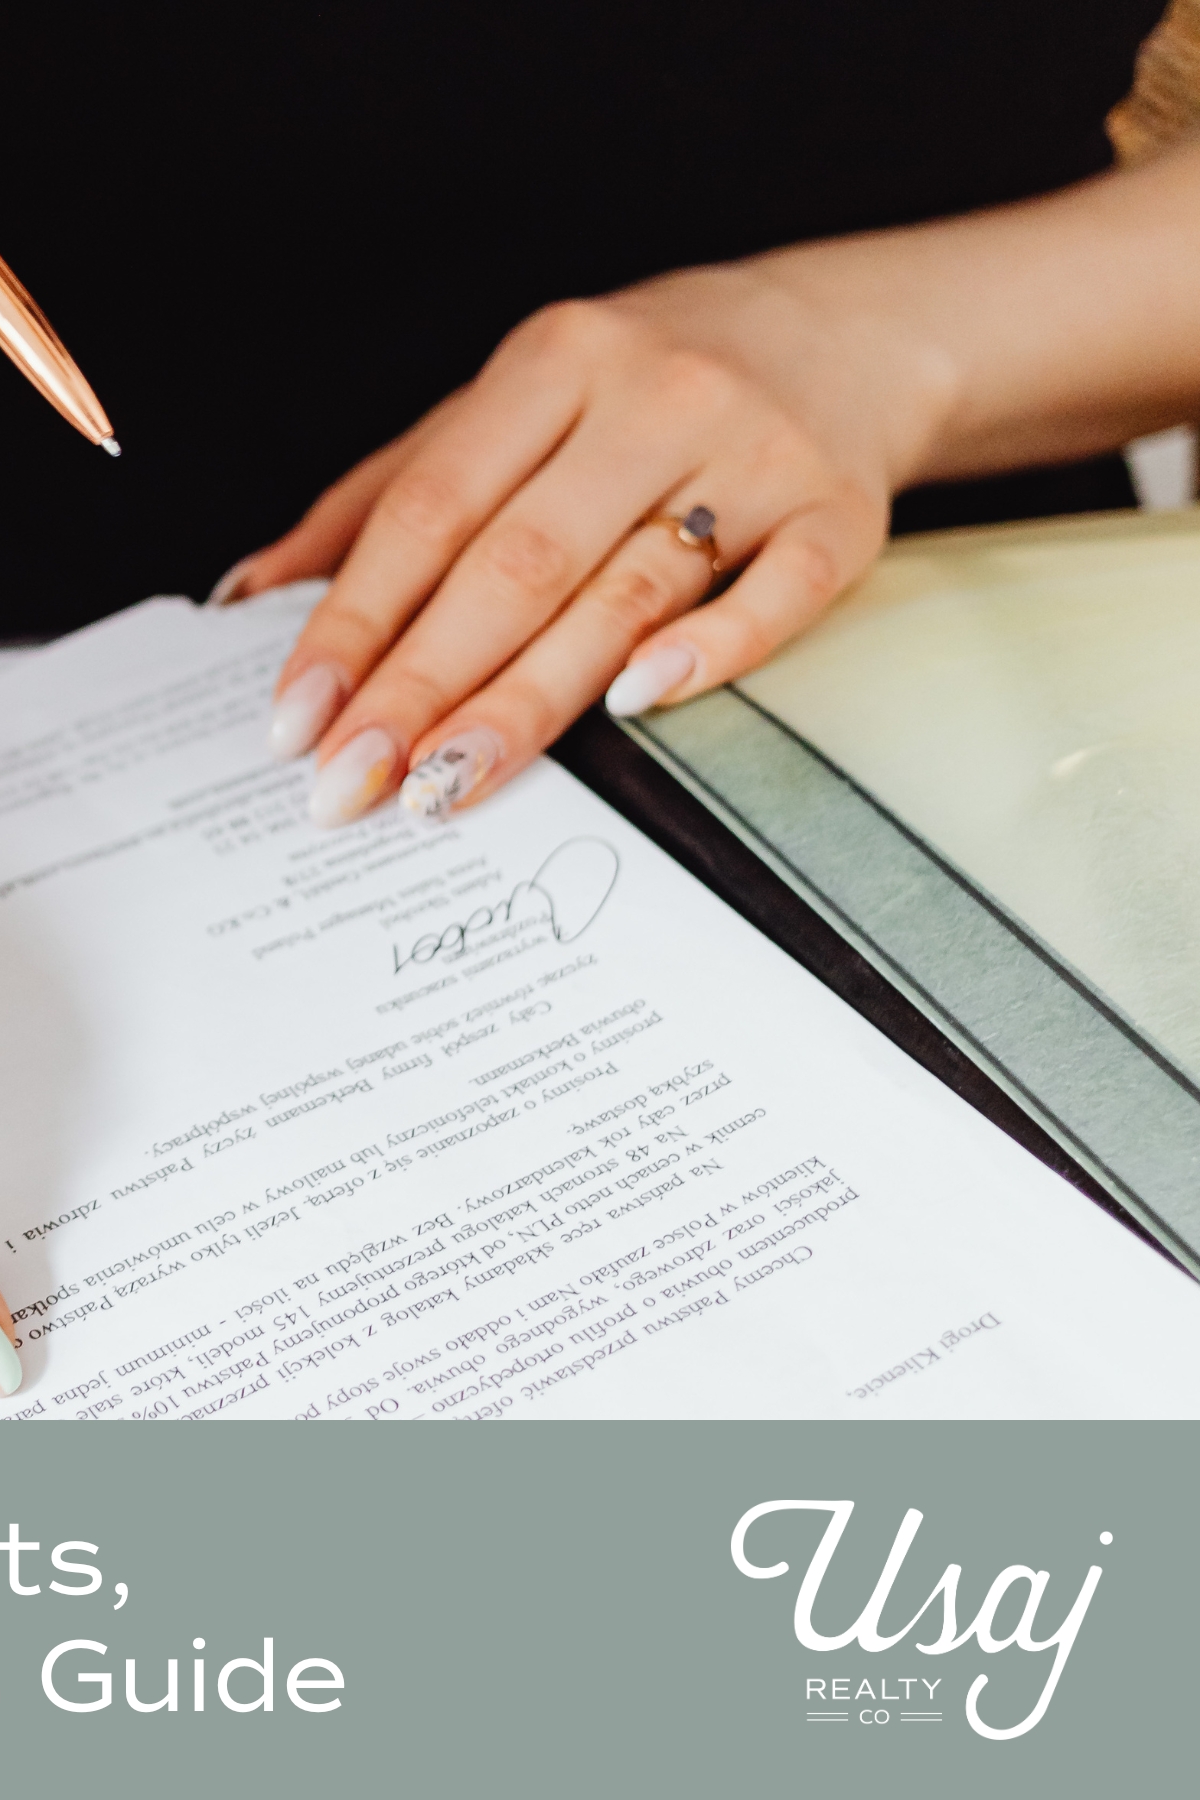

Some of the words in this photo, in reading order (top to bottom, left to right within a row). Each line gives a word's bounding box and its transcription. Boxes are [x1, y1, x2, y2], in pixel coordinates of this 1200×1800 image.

[408, 1016, 460, 1045] sobie
[507, 999, 553, 1025] Cały
[577, 997, 647, 1036] obuwia
[439, 1022, 500, 1058] zespół
[589, 1008, 664, 1056] prosimy
[344, 1040, 409, 1074] udanej
[380, 1051, 434, 1081] firmy
[467, 1031, 581, 1086] Berkemann.
[572, 1051, 587, 1063] o
[498, 1058, 574, 1099] kontakt
[540, 1059, 620, 1104] Prosimy
[647, 1058, 715, 1097] szybką
[678, 1071, 733, 1106] przez
[263, 1077, 375, 1128] Berkemann
[385, 1093, 500, 1149] telefoniczny
[522, 1099, 537, 1111] o
[565, 1093, 648, 1135] dostawę.
[636, 1104, 676, 1130] cały
[201, 1125, 257, 1159] życzy
[414, 1105, 521, 1159] zapoznanie
[596, 1125, 633, 1149] rok
[652, 1123, 689, 1144] Na
[702, 1106, 767, 1145] cennik
[348, 1142, 385, 1165] lub
[382, 1153, 413, 1173] się
[624, 1143, 649, 1162] 48
[684, 1142, 704, 1156] w
[687, 1156, 724, 1177] Na
[108, 1155, 195, 1200] Państwu
[264, 1158, 347, 1204] mailowy
[365, 1167, 382, 1181] z
[456, 1144, 598, 1214] kalendarzowy.
[537, 1157, 620, 1203] stronach
[613, 1152, 681, 1190] cenach
[740, 1154, 827, 1205] klientów
[241, 1200, 261, 1215] w
[301, 1176, 365, 1207] ofertą.
[563, 1185, 614, 1215] netto
[604, 1171, 686, 1220] państwa
[718, 1201, 739, 1217] w
[772, 1166, 845, 1217] jakości
[21, 1198, 101, 1241] zdrowia
[192, 1209, 237, 1235] celu
[242, 1205, 301, 1241] Jeżeli
[410, 1211, 455, 1236] Bez
[449, 1198, 539, 1244] katalogu
[506, 1211, 566, 1243] PLN,
[559, 1217, 603, 1244] ręce
[651, 1211, 720, 1249] Polsce
[721, 1213, 766, 1241] oraz
[736, 1184, 861, 1260] producentem
[3, 1238, 17, 1254] i
[81, 1230, 192, 1287] umówienia
[189, 1232, 242, 1262] tylko
[323, 1234, 408, 1276] względu
[478, 1238, 507, 1260] od
[578, 1244, 651, 1286] zaufało
[612, 1238, 717, 1291] zdrowego,
[112, 1260, 187, 1298] wyrażą
[291, 1271, 321, 1290] na
[316, 1236, 447, 1307] prezentujemy
[403, 1250, 482, 1291] którego
[463, 1240, 555, 1291] składamy
[658, 1258, 733, 1299] obuwia
[732, 1244, 813, 1292] Chcemy
[232, 1286, 292, 1323] ilości
[379, 1287, 460, 1327] katalog
[513, 1307, 529, 1322] i
[525, 1282, 581, 1312] Nam
[640, 1288, 730, 1335] Państwu
[641, 1296, 657, 1308] o
[27, 1293, 114, 1340] Państwo
[271, 1304, 311, 1332] 145
[272, 1282, 401, 1355] proponujemy
[360, 1323, 378, 1338] z
[444, 1314, 512, 1351] oddało
[494, 1294, 609, 1354] wygodnego
[567, 1301, 638, 1345] profilu
[938, 1310, 1002, 1353] Drogi
[113, 1323, 213, 1377] minimum
[186, 1324, 266, 1369] modeli,
[276, 1332, 361, 1383] kolekcji
[381, 1346, 442, 1381] swoje
[519, 1328, 639, 1401] przedstawić
[50, 1368, 112, 1405] jedna
[129, 1364, 187, 1396] które
[180, 1349, 271, 1398] Państwu
[405, 1353, 486, 1394] obuwia.
[430, 1342, 564, 1413] ortopedyczno
[845, 1345, 942, 1399] Kliencie,
[74, 1392, 124, 1419] stale
[130, 1393, 180, 1419] 10%
[179, 1371, 272, 1419] przeznac
[325, 1376, 380, 1411] stopy
[363, 1397, 400, 1419] Od
[451, 1394, 514, 1419] ofert
